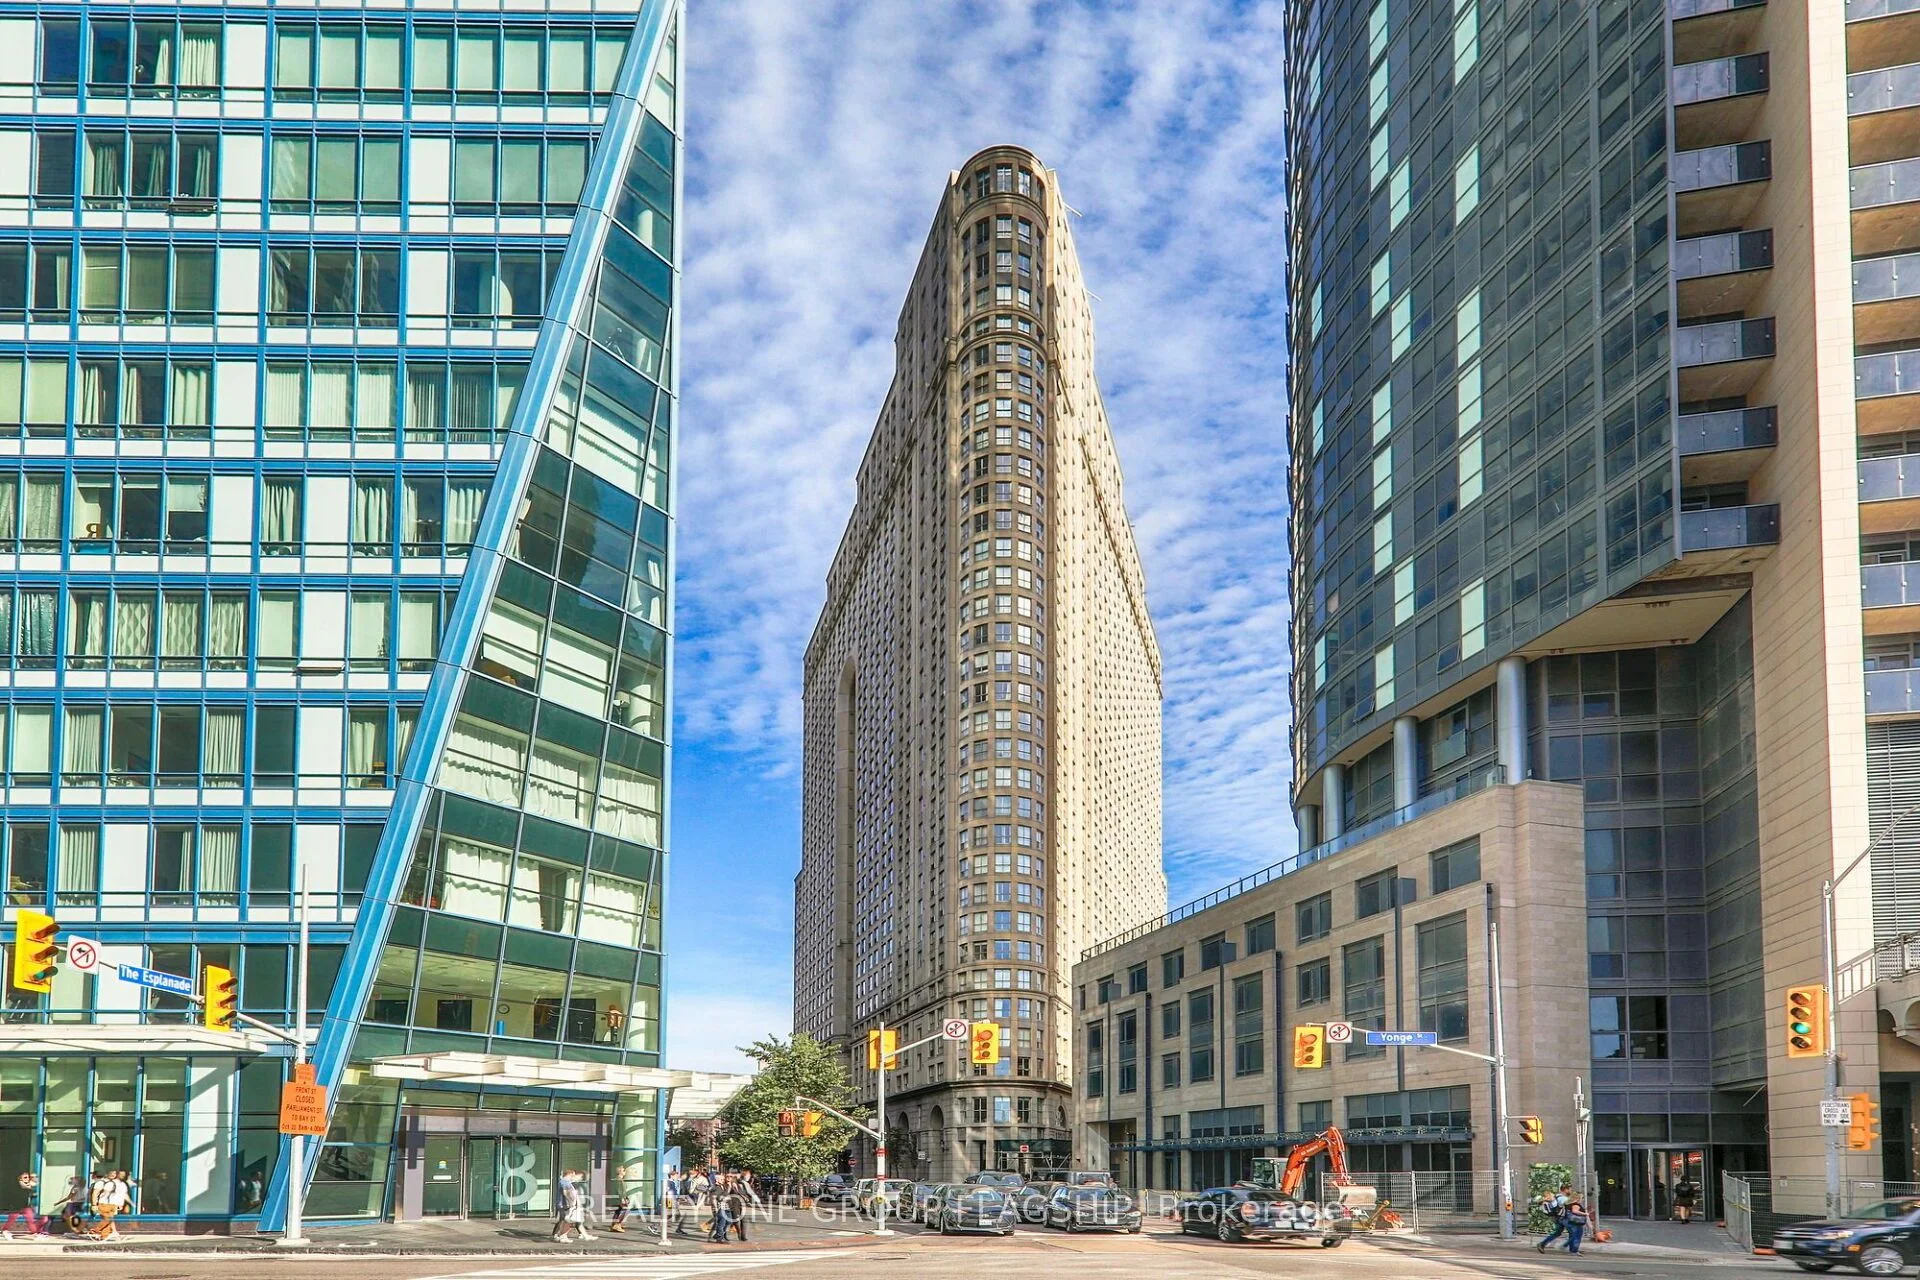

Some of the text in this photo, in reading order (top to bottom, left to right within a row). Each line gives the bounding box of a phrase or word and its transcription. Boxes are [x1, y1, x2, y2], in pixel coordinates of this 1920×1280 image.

[120, 965, 191, 991] The Esplanade
[1381, 1033, 1413, 1044] Yonge
[296, 1095, 315, 1103] CLOSED
[286, 1104, 316, 1113] PARLIAMENT
[502, 1145, 538, 1206] 8
